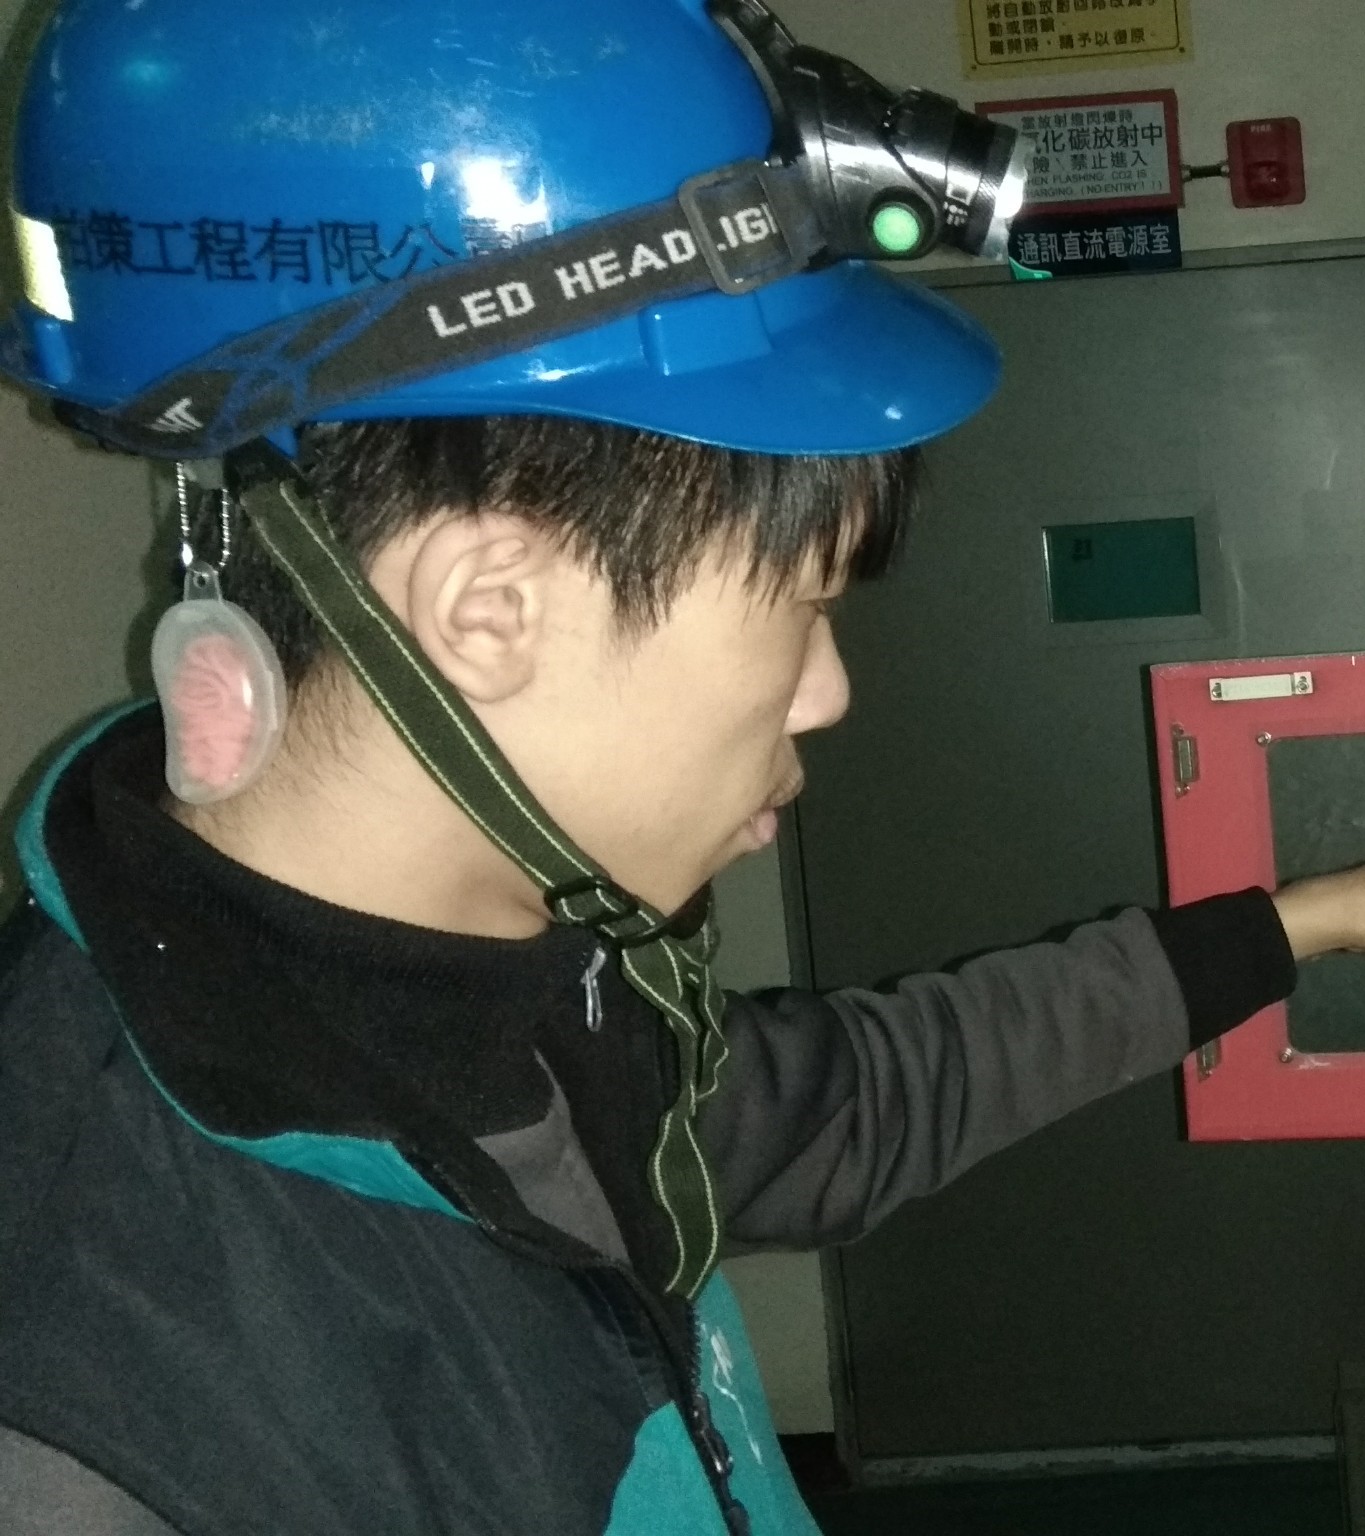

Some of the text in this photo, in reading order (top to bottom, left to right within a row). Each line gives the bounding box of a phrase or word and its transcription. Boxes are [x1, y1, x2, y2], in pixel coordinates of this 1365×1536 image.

[1016, 222, 1173, 265] 通訊直流電源室
[427, 281, 536, 338] LED
